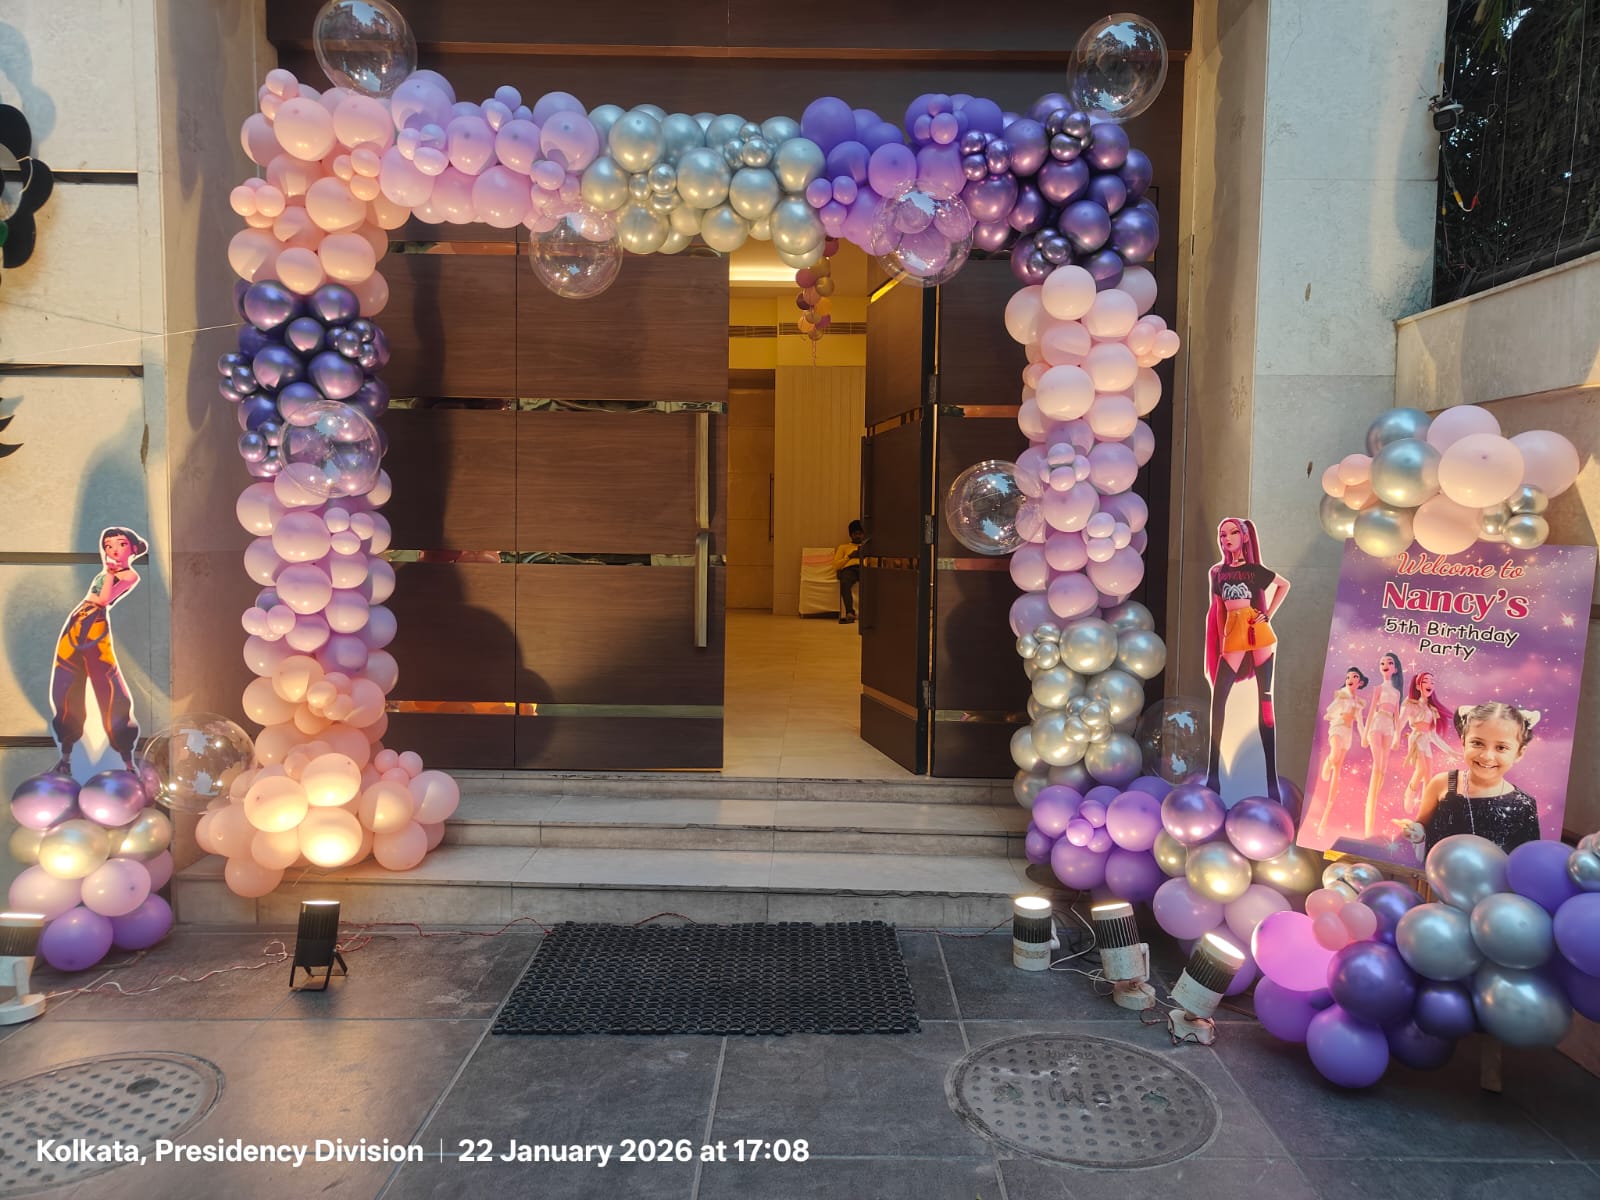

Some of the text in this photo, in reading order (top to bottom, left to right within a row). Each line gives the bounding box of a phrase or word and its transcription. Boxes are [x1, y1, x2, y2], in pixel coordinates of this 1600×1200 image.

[1397, 552, 1526, 579] Welcome to
[1382, 581, 1530, 621] Nancy's
[1384, 617, 1519, 648] 5th Birthday
[1418, 638, 1476, 661] Party
